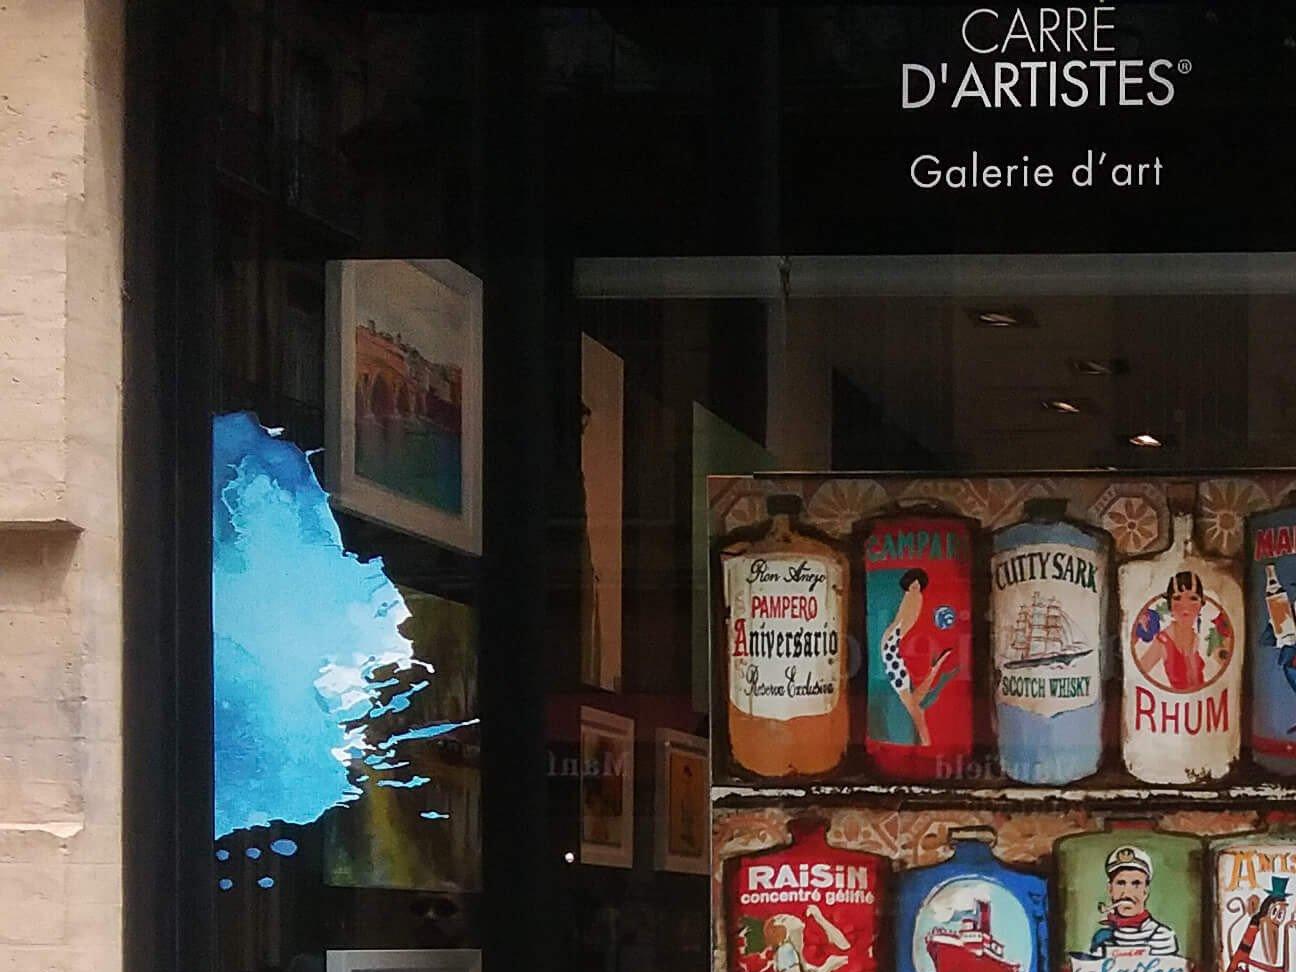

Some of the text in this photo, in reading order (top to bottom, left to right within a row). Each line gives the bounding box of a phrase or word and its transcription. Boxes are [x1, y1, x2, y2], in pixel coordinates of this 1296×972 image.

[910, 150, 1054, 188] Galerie
[995, 551, 1098, 593] CUTTY SARK
[751, 595, 818, 622] PAMPERO
[732, 617, 839, 659] Aniversario
[1001, 675, 1092, 699] SCOTCH WHISKY
[1134, 685, 1230, 736] RHUM
